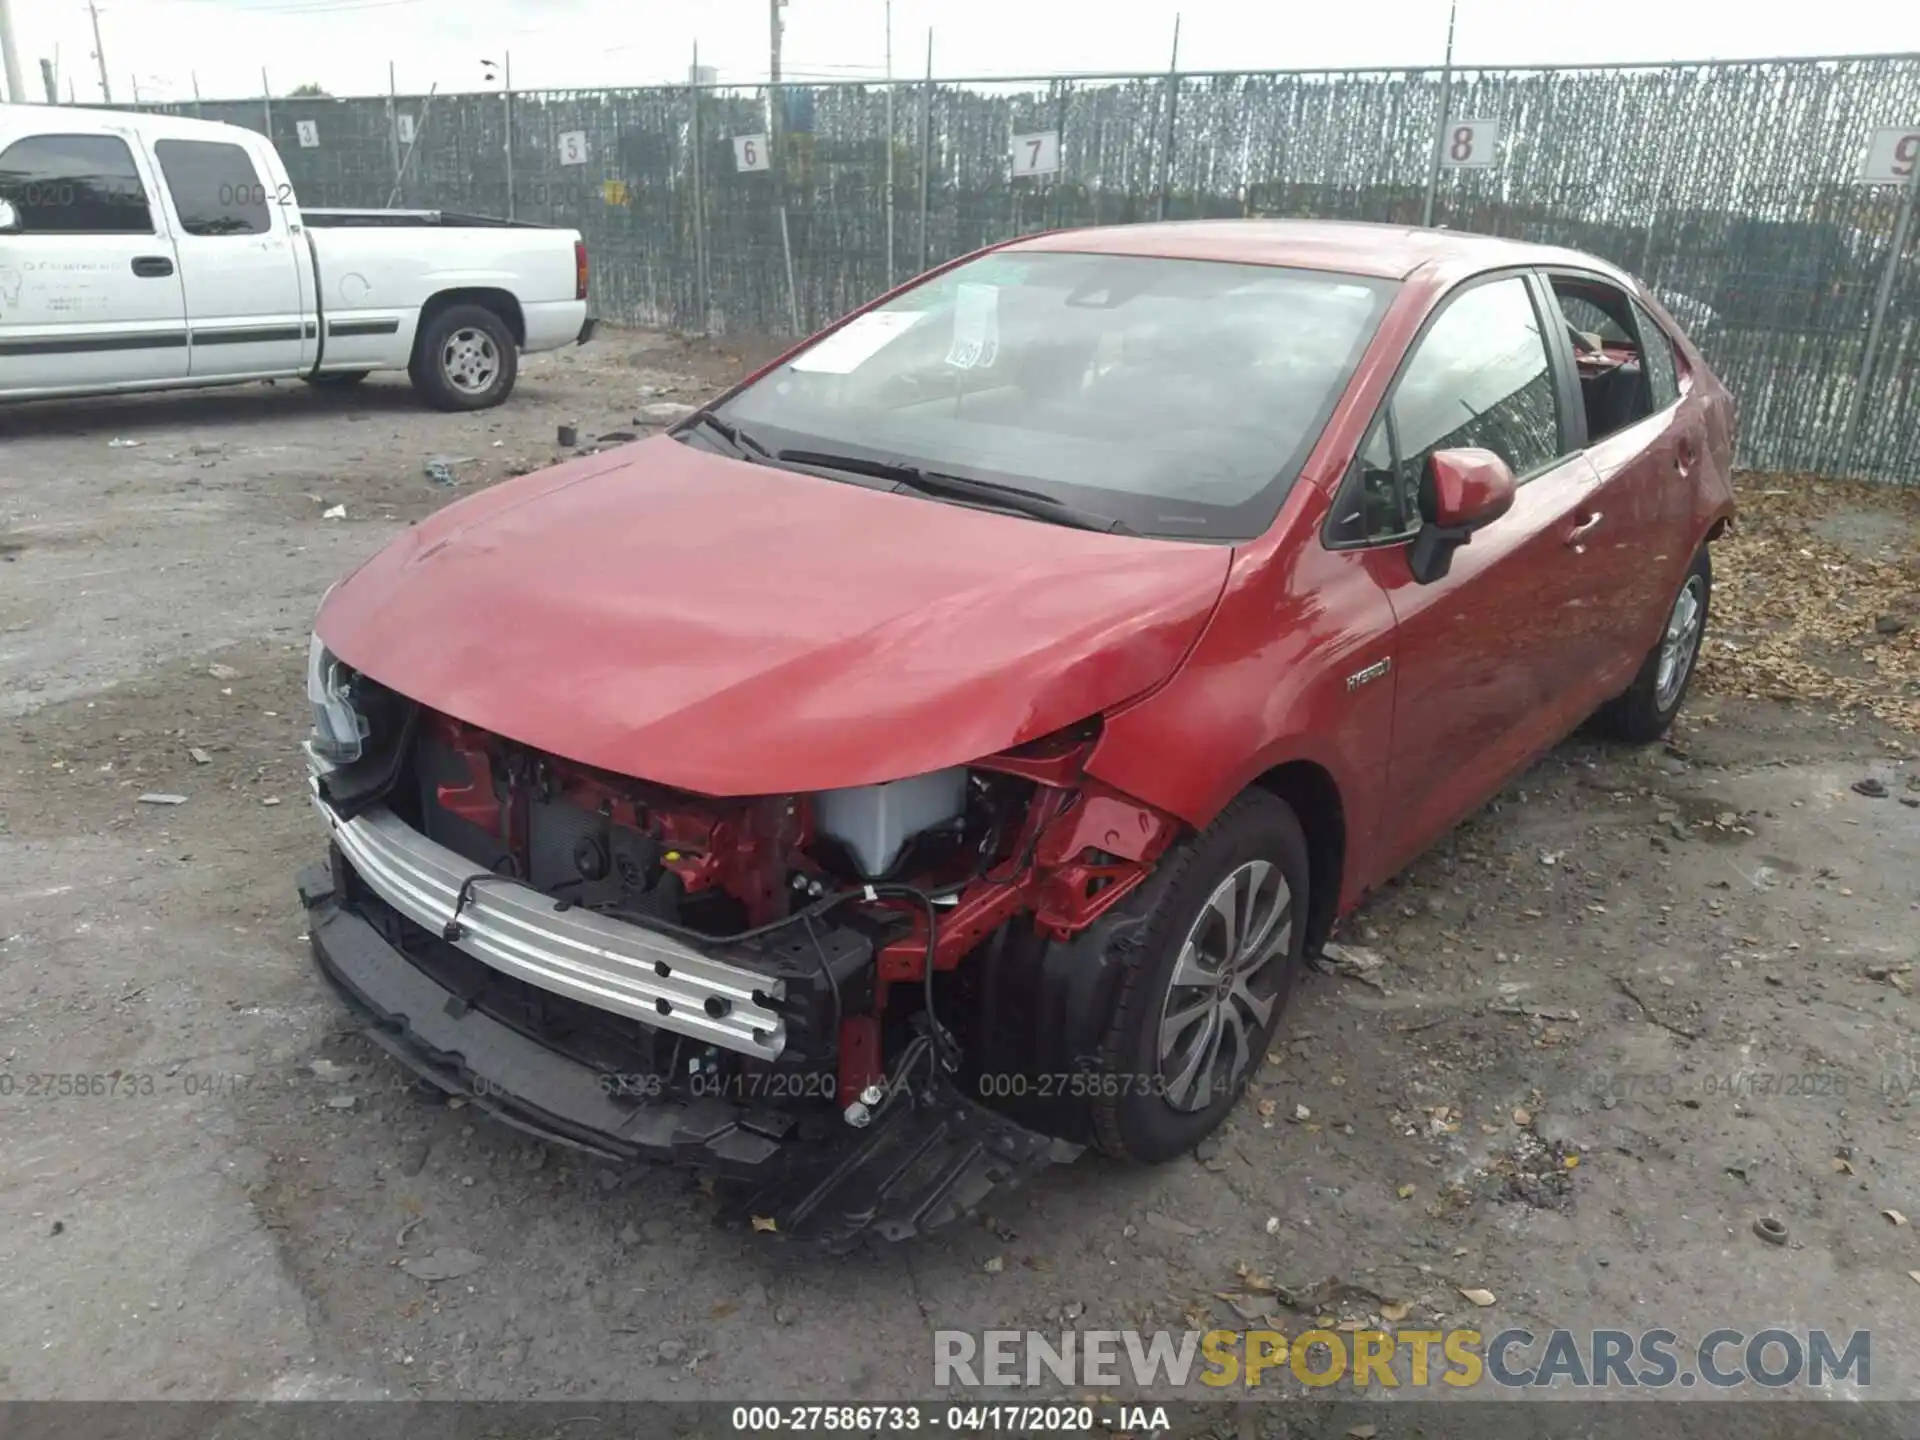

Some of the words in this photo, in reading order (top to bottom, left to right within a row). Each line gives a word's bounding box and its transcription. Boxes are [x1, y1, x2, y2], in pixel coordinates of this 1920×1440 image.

[568, 138, 578, 160] 5
[743, 140, 757, 166] 6
[1024, 138, 1044, 169] 7
[1451, 126, 1474, 162] 8
[1891, 134, 1920, 176] 9
